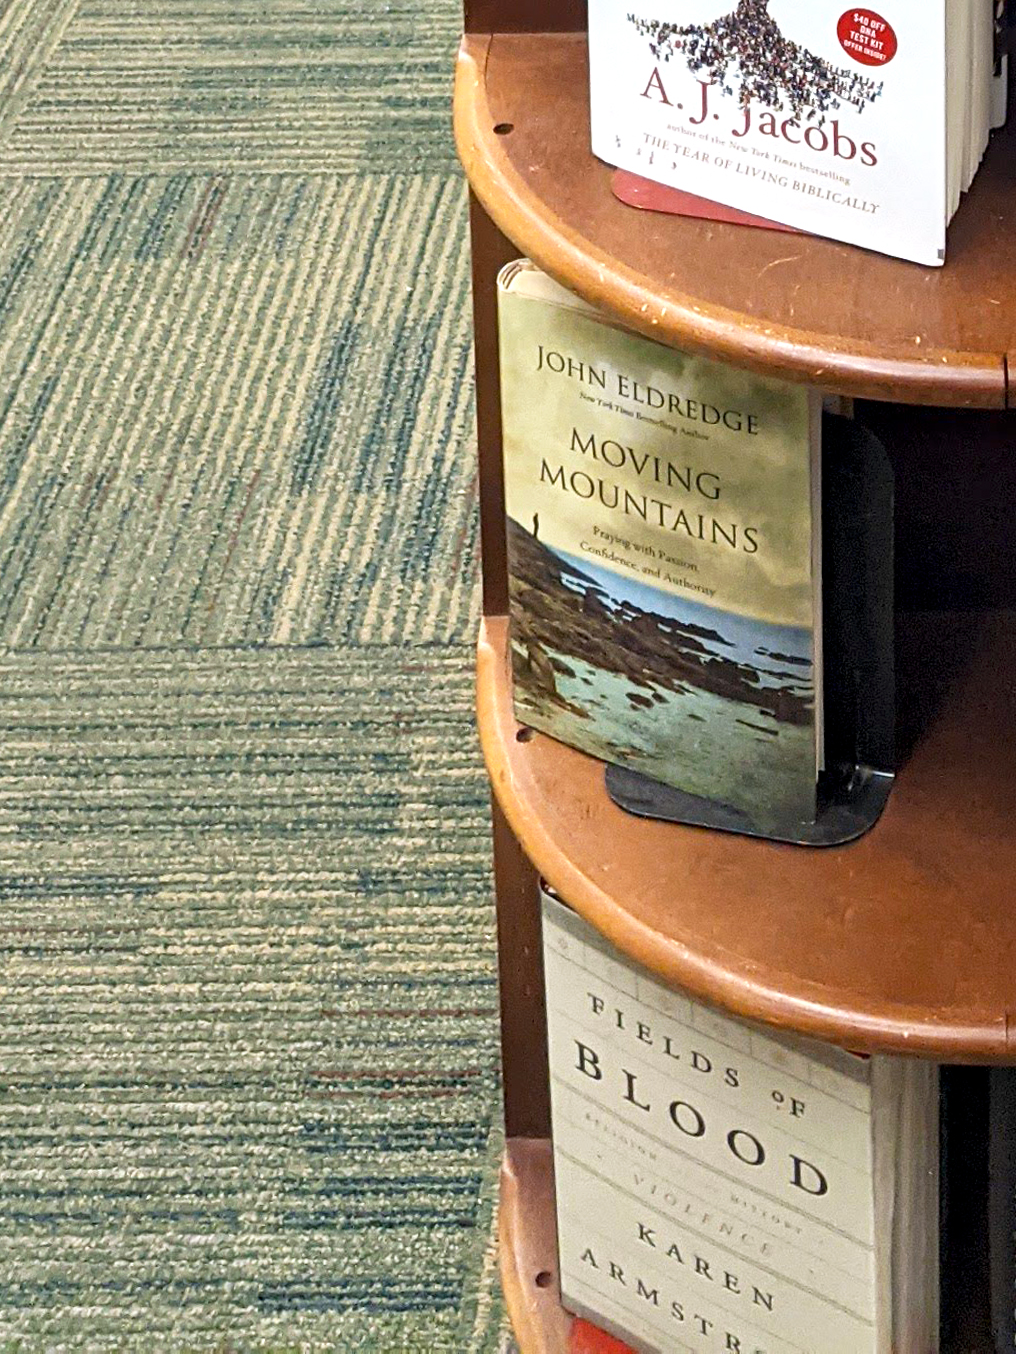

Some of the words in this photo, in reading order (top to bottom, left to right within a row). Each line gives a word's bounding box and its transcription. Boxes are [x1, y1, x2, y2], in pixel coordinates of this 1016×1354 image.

[850, 30, 869, 45] TEST
[870, 38, 884, 51] KIT
[860, 25, 876, 38] DNA
[870, 19, 886, 33] OFF
[640, 66, 684, 110] A.
[689, 79, 720, 126] J.
[731, 96, 879, 168] Jacobs
[643, 132, 669, 153] THE
[673, 140, 710, 164] YEAR
[714, 153, 733, 171] OF
[735, 160, 789, 188] LIVING
[791, 178, 881, 216] BIBLICALLY
[536, 346, 607, 390] JOHN
[617, 375, 760, 436] ELDREDGE
[540, 458, 760, 555] MOUNTAINS
[570, 427, 721, 501] MOVING
[579, 541, 640, 573] Confidence,
[641, 564, 661, 580] and
[664, 574, 717, 598] Authority
[593, 526, 630, 550] Praying
[634, 539, 656, 558] with
[587, 991, 740, 1088] FIELDS
[771, 1090, 806, 1118] OF
[574, 1038, 829, 1198] BLOOD
[580, 1247, 768, 1354] ARMSTR
[637, 1221, 774, 1312] KAREN
